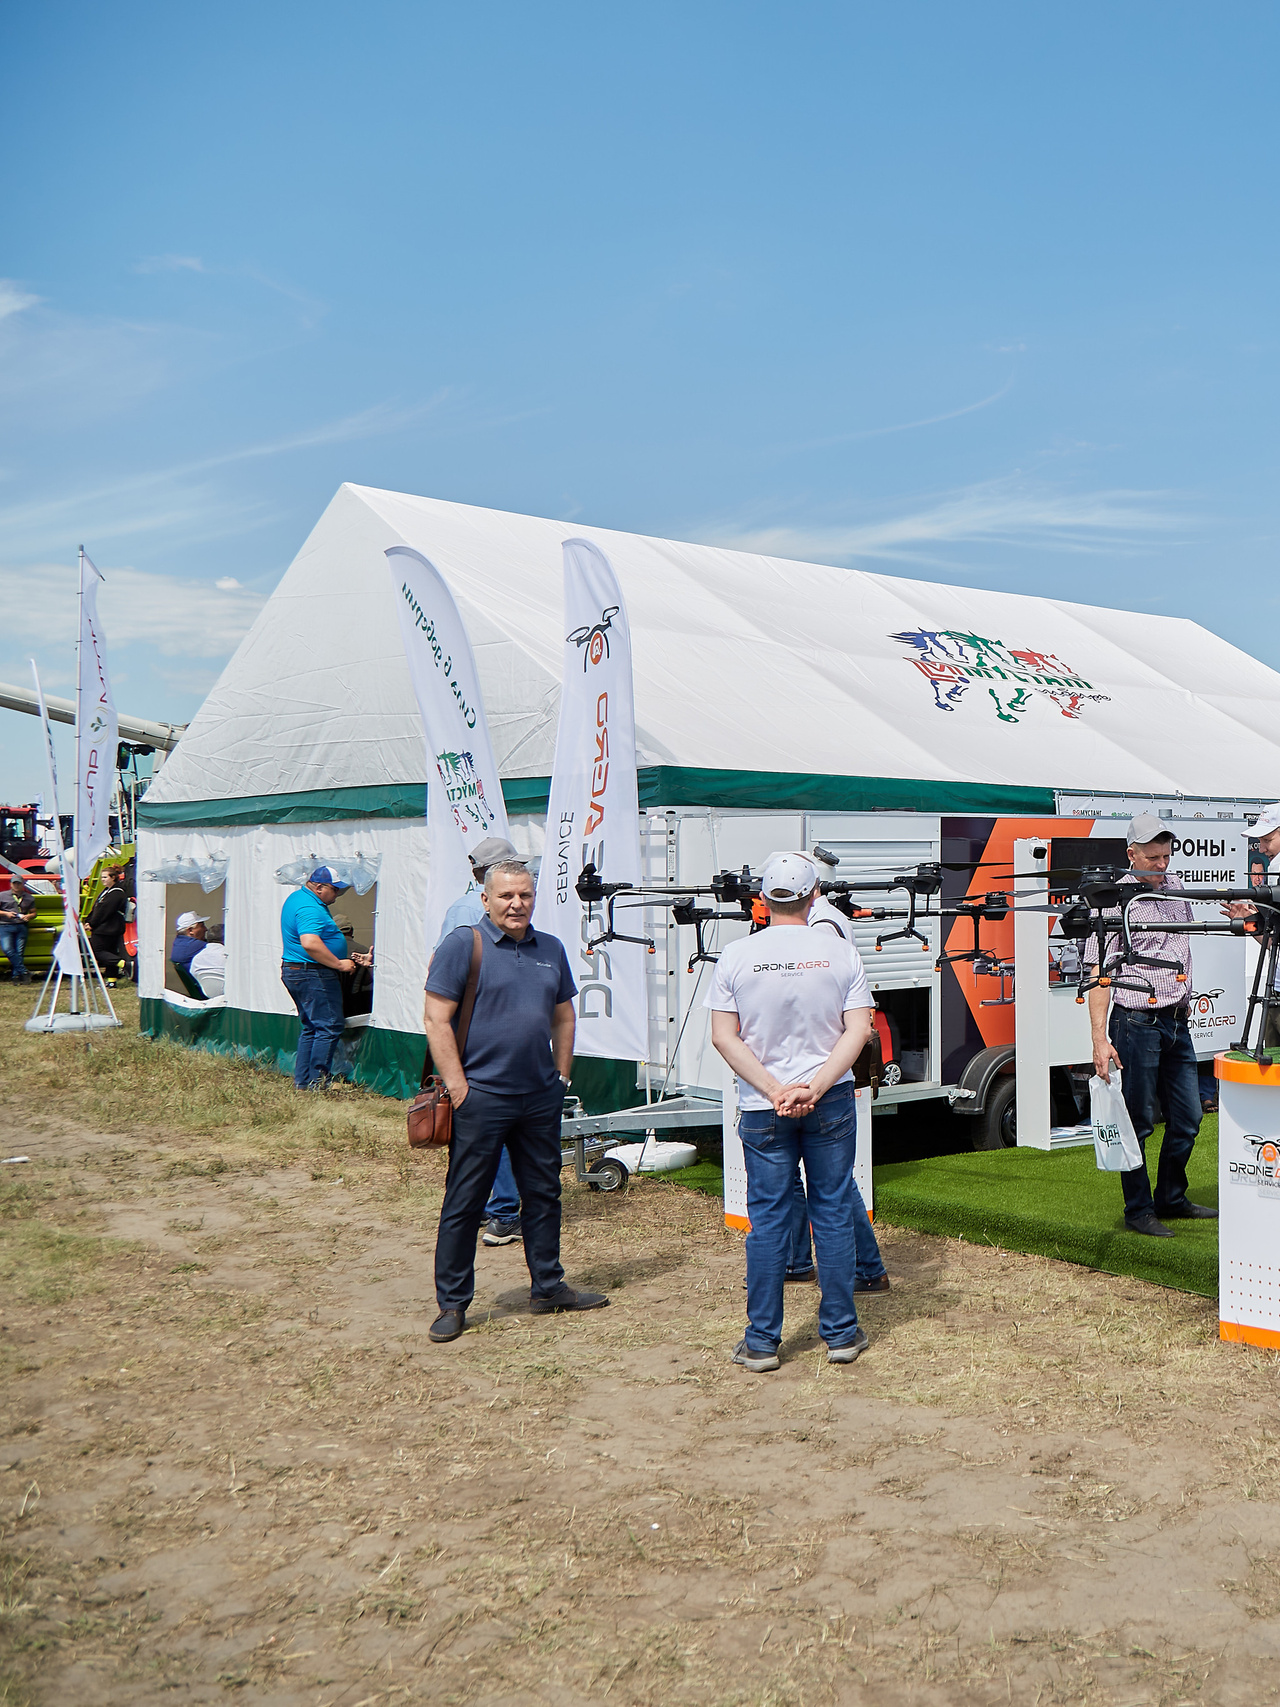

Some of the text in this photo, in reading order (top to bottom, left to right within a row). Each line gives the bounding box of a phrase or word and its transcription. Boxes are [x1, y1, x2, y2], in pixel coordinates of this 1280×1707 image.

[1171, 838, 1225, 857] РОНЫ
[1187, 1015, 1237, 1029] ONEAGRO
[1194, 1031, 1214, 1039] SERVICE
